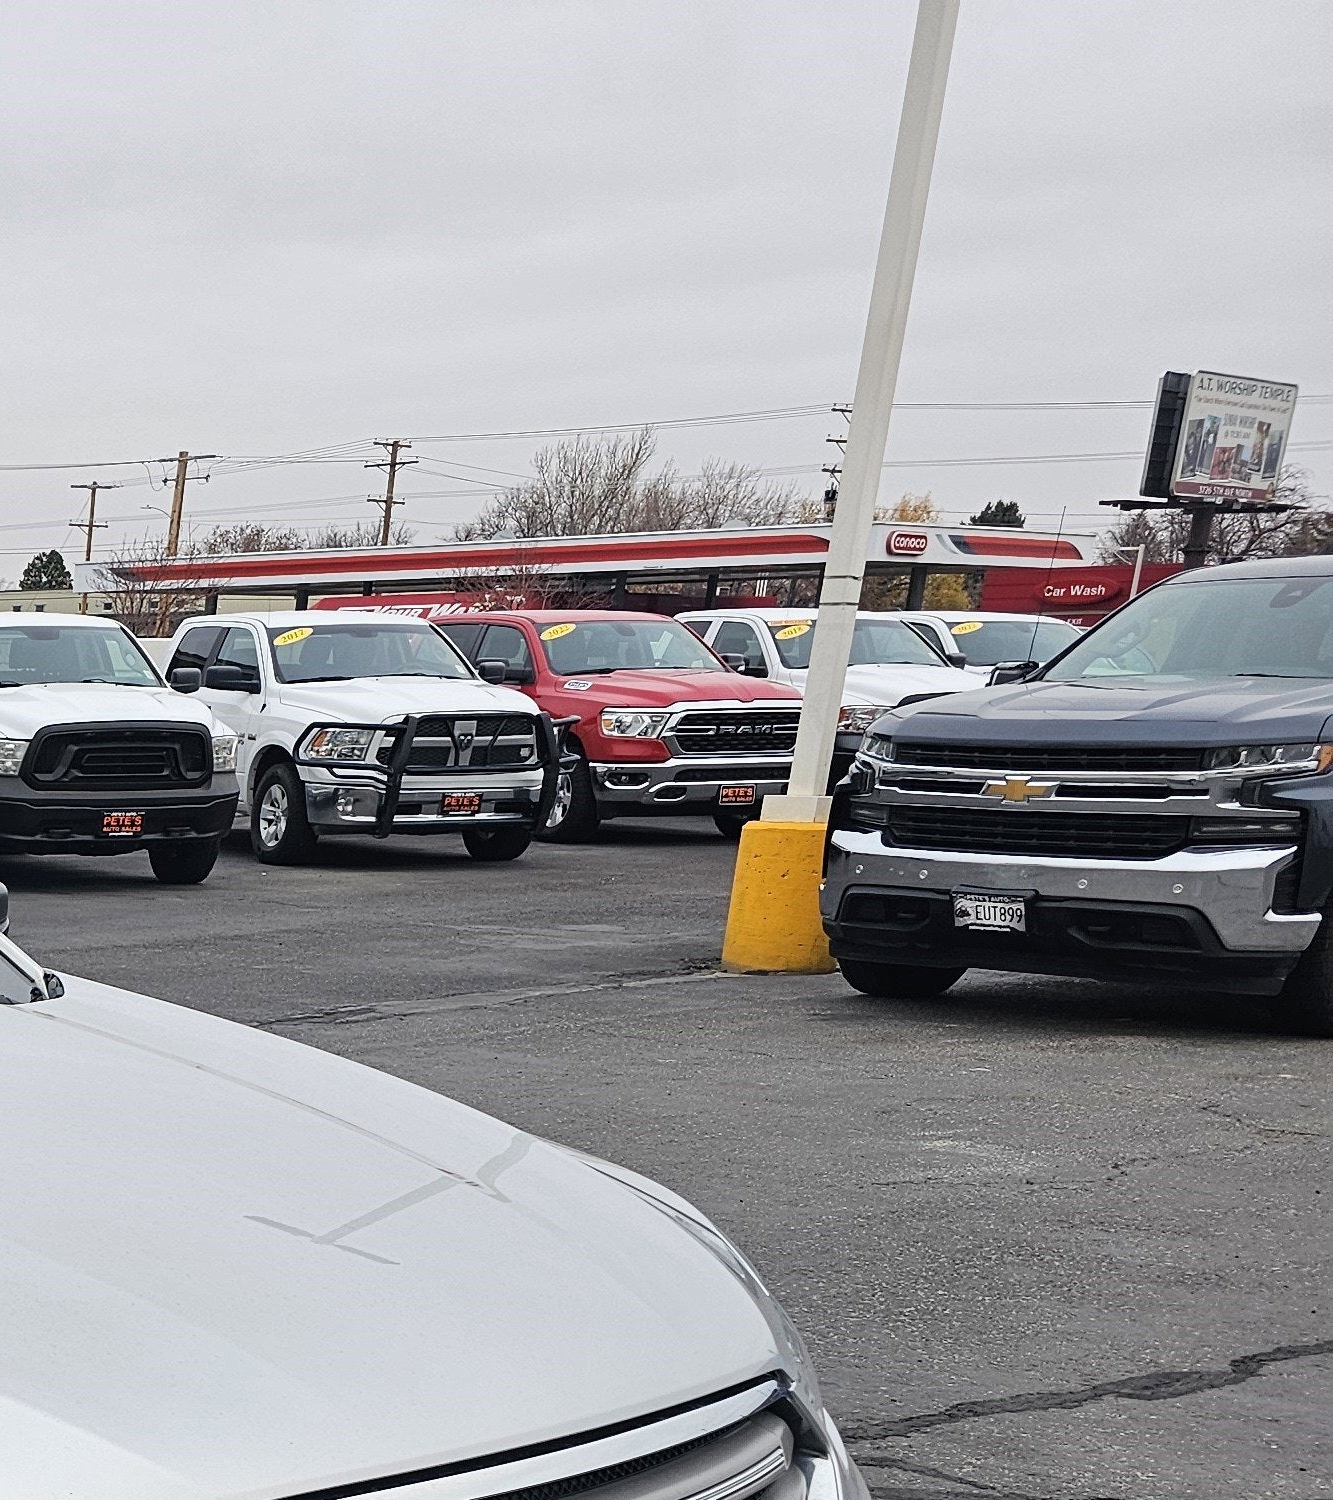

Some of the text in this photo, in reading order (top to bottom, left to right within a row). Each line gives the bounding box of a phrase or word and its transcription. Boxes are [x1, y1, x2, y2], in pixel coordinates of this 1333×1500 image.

[1216, 379, 1258, 397] WORSHIP
[1258, 385, 1294, 403] TEMPLE
[895, 536, 926, 549] conoco
[1044, 585, 1106, 597] Car Wash
[719, 725, 775, 734] RAM
[722, 787, 753, 796] PETE'S
[444, 796, 480, 806] PETE'S
[103, 816, 142, 825] PETE'S
[975, 904, 1023, 924] EUT899
